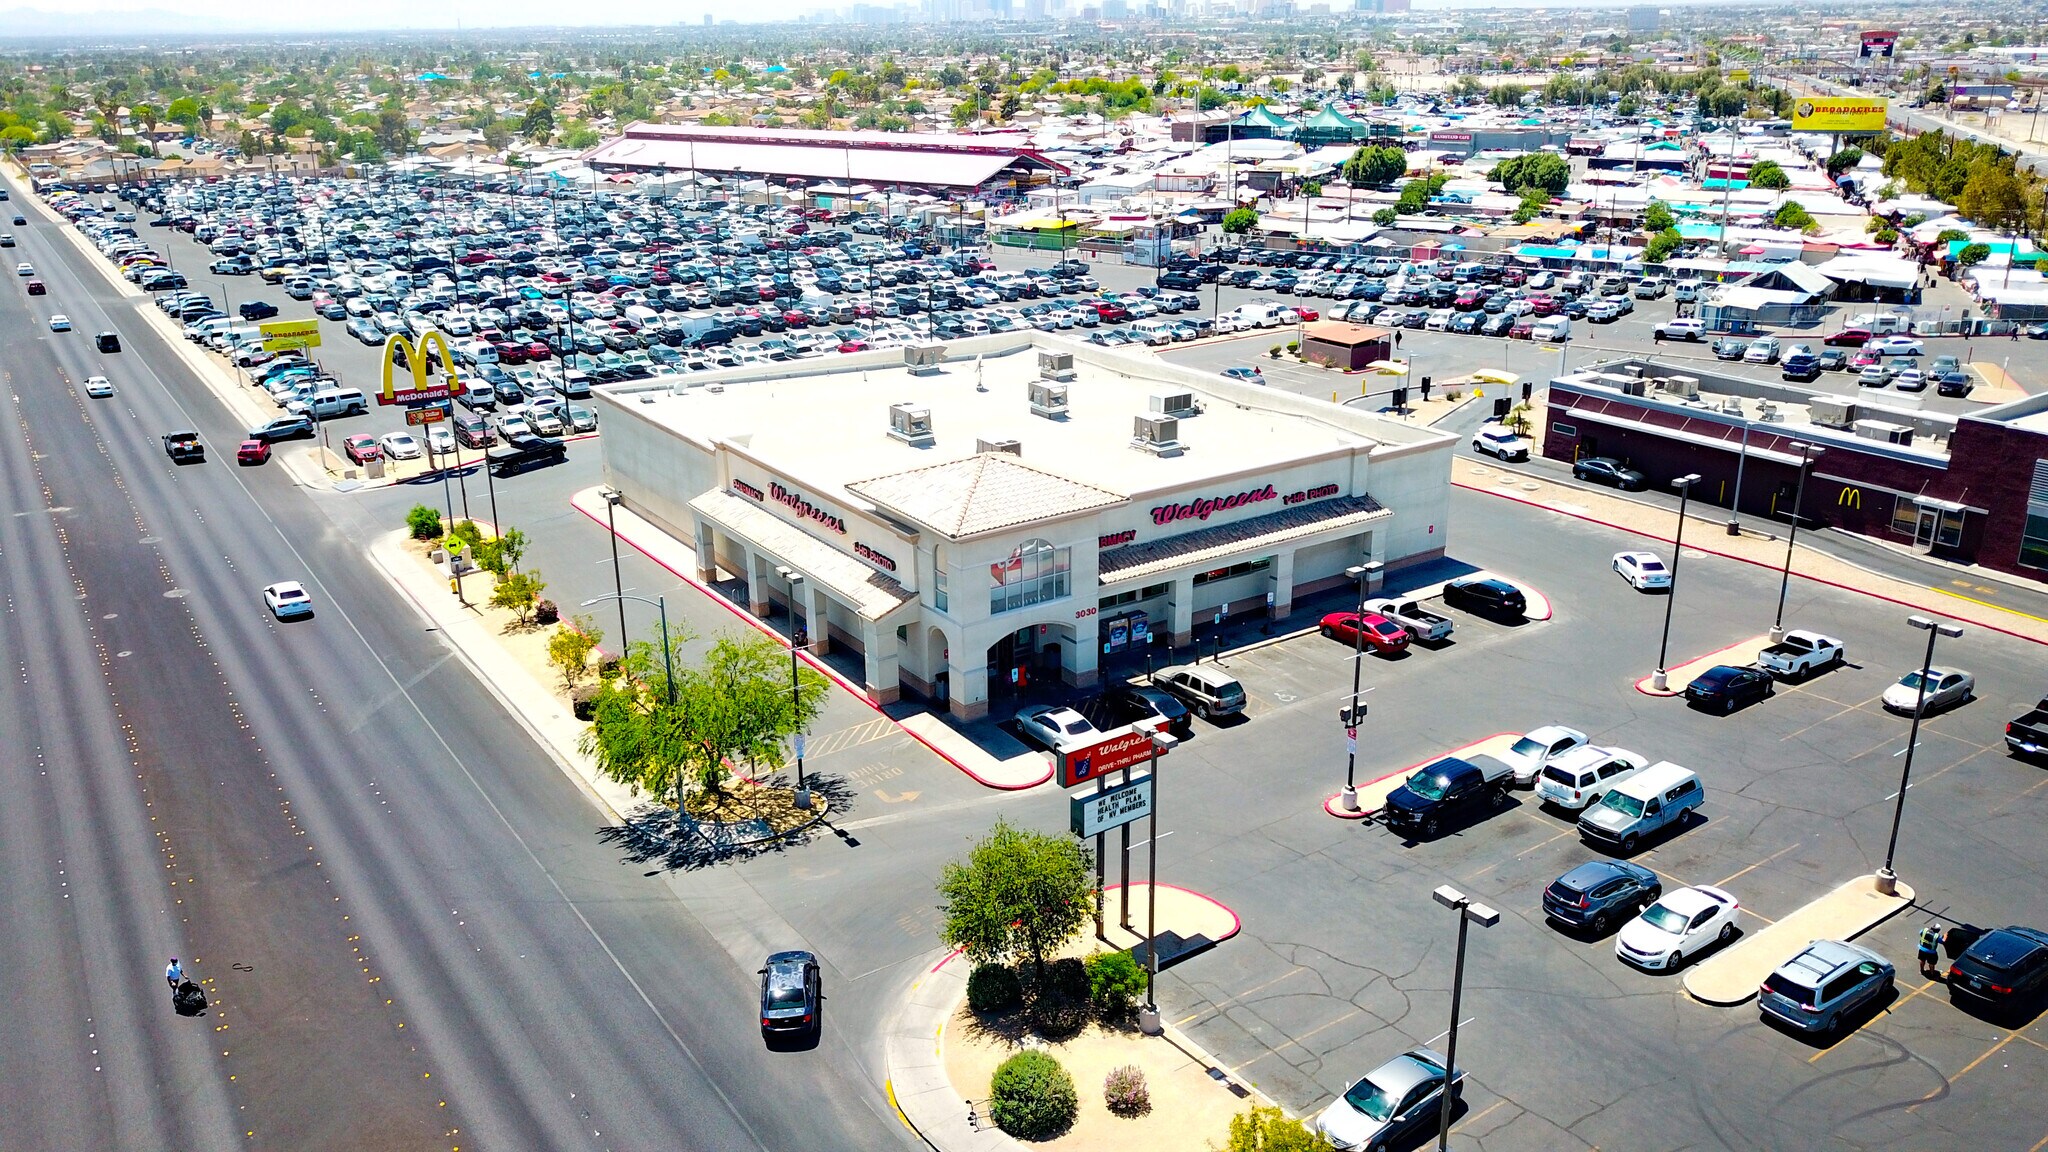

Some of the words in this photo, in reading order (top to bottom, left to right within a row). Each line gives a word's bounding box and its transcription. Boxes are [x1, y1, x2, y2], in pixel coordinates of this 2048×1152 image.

[396, 389, 449, 402] McDonald's
[733, 478, 764, 501] PHARMACY
[1307, 484, 1340, 500] PHOTO
[767, 481, 847, 535] Walgreens
[1150, 484, 1278, 525] Walgreens
[1099, 530, 1137, 548] RMACY
[870, 550, 896, 571] PHOTO
[1075, 607, 1097, 619] 3030
[1097, 756, 1132, 773] DRIVE-THRU
[1132, 746, 1162, 761] PHARMY
[1097, 801, 1120, 815] HEALTH
[1125, 793, 1142, 805] PLAN
[1098, 799, 1106, 807] WE
[1110, 787, 1137, 802] WELCOME
[1097, 815, 1104, 823] OF
[1108, 809, 1117, 819] NV
[1119, 799, 1147, 814] MEMBERS
